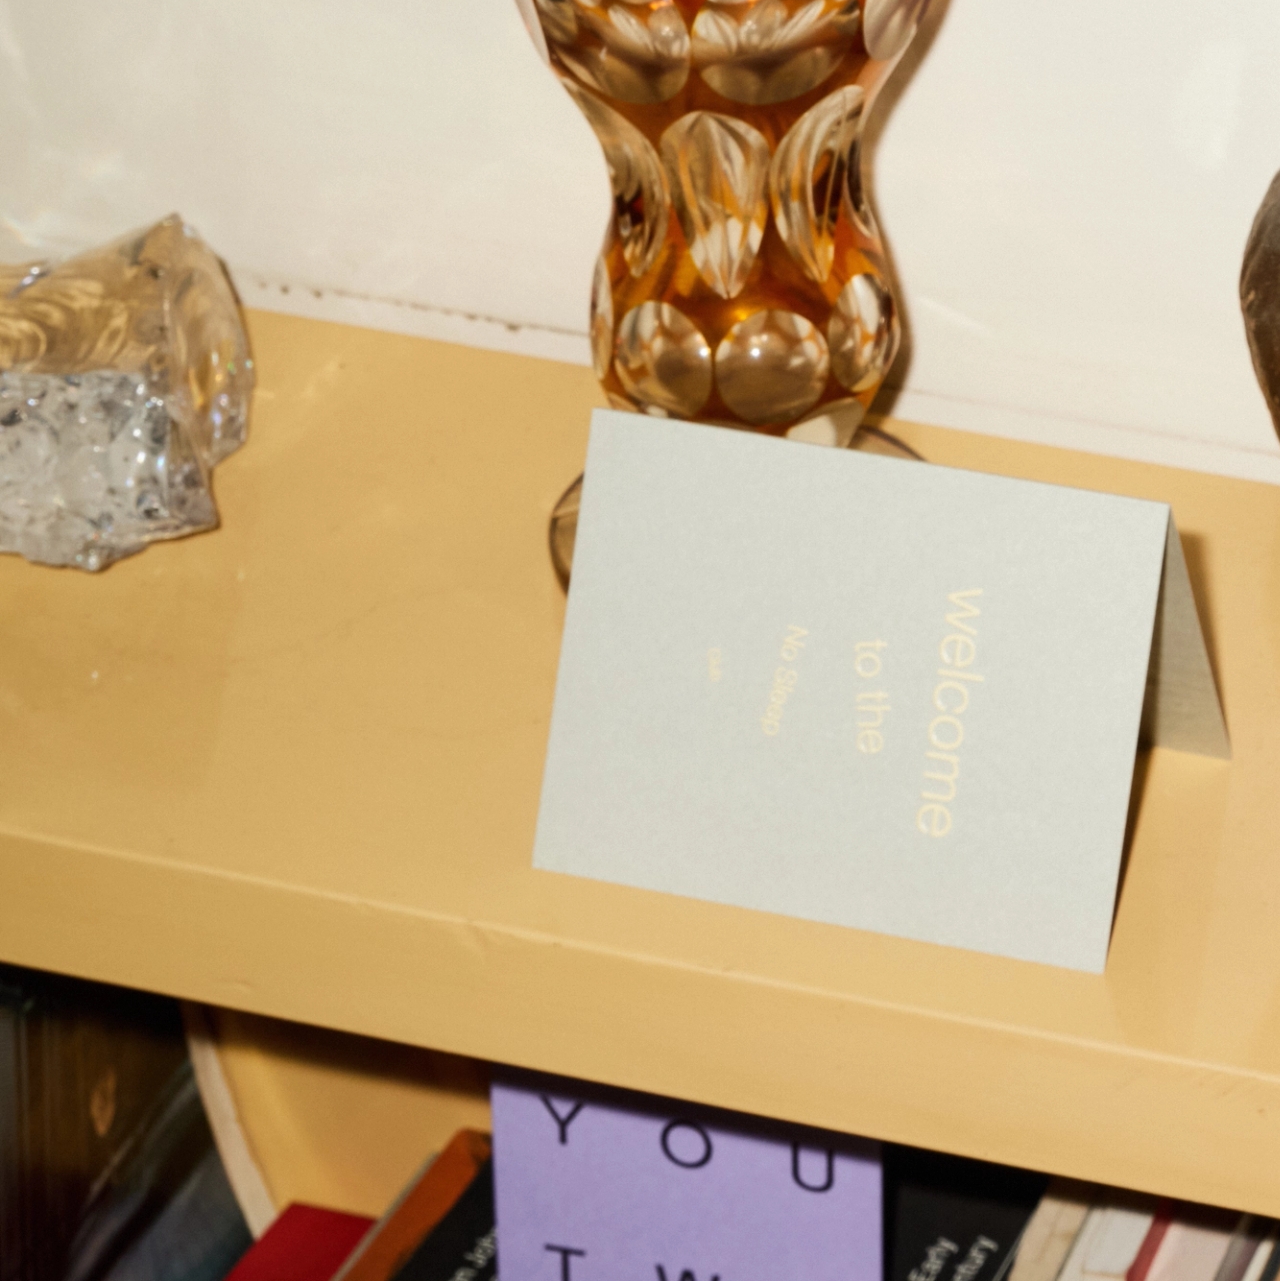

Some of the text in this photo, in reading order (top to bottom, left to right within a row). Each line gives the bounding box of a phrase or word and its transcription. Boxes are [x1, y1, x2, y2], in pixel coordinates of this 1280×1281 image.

[780, 624, 810, 662] No
[854, 639, 892, 755] to the
[915, 588, 985, 839] welcome
